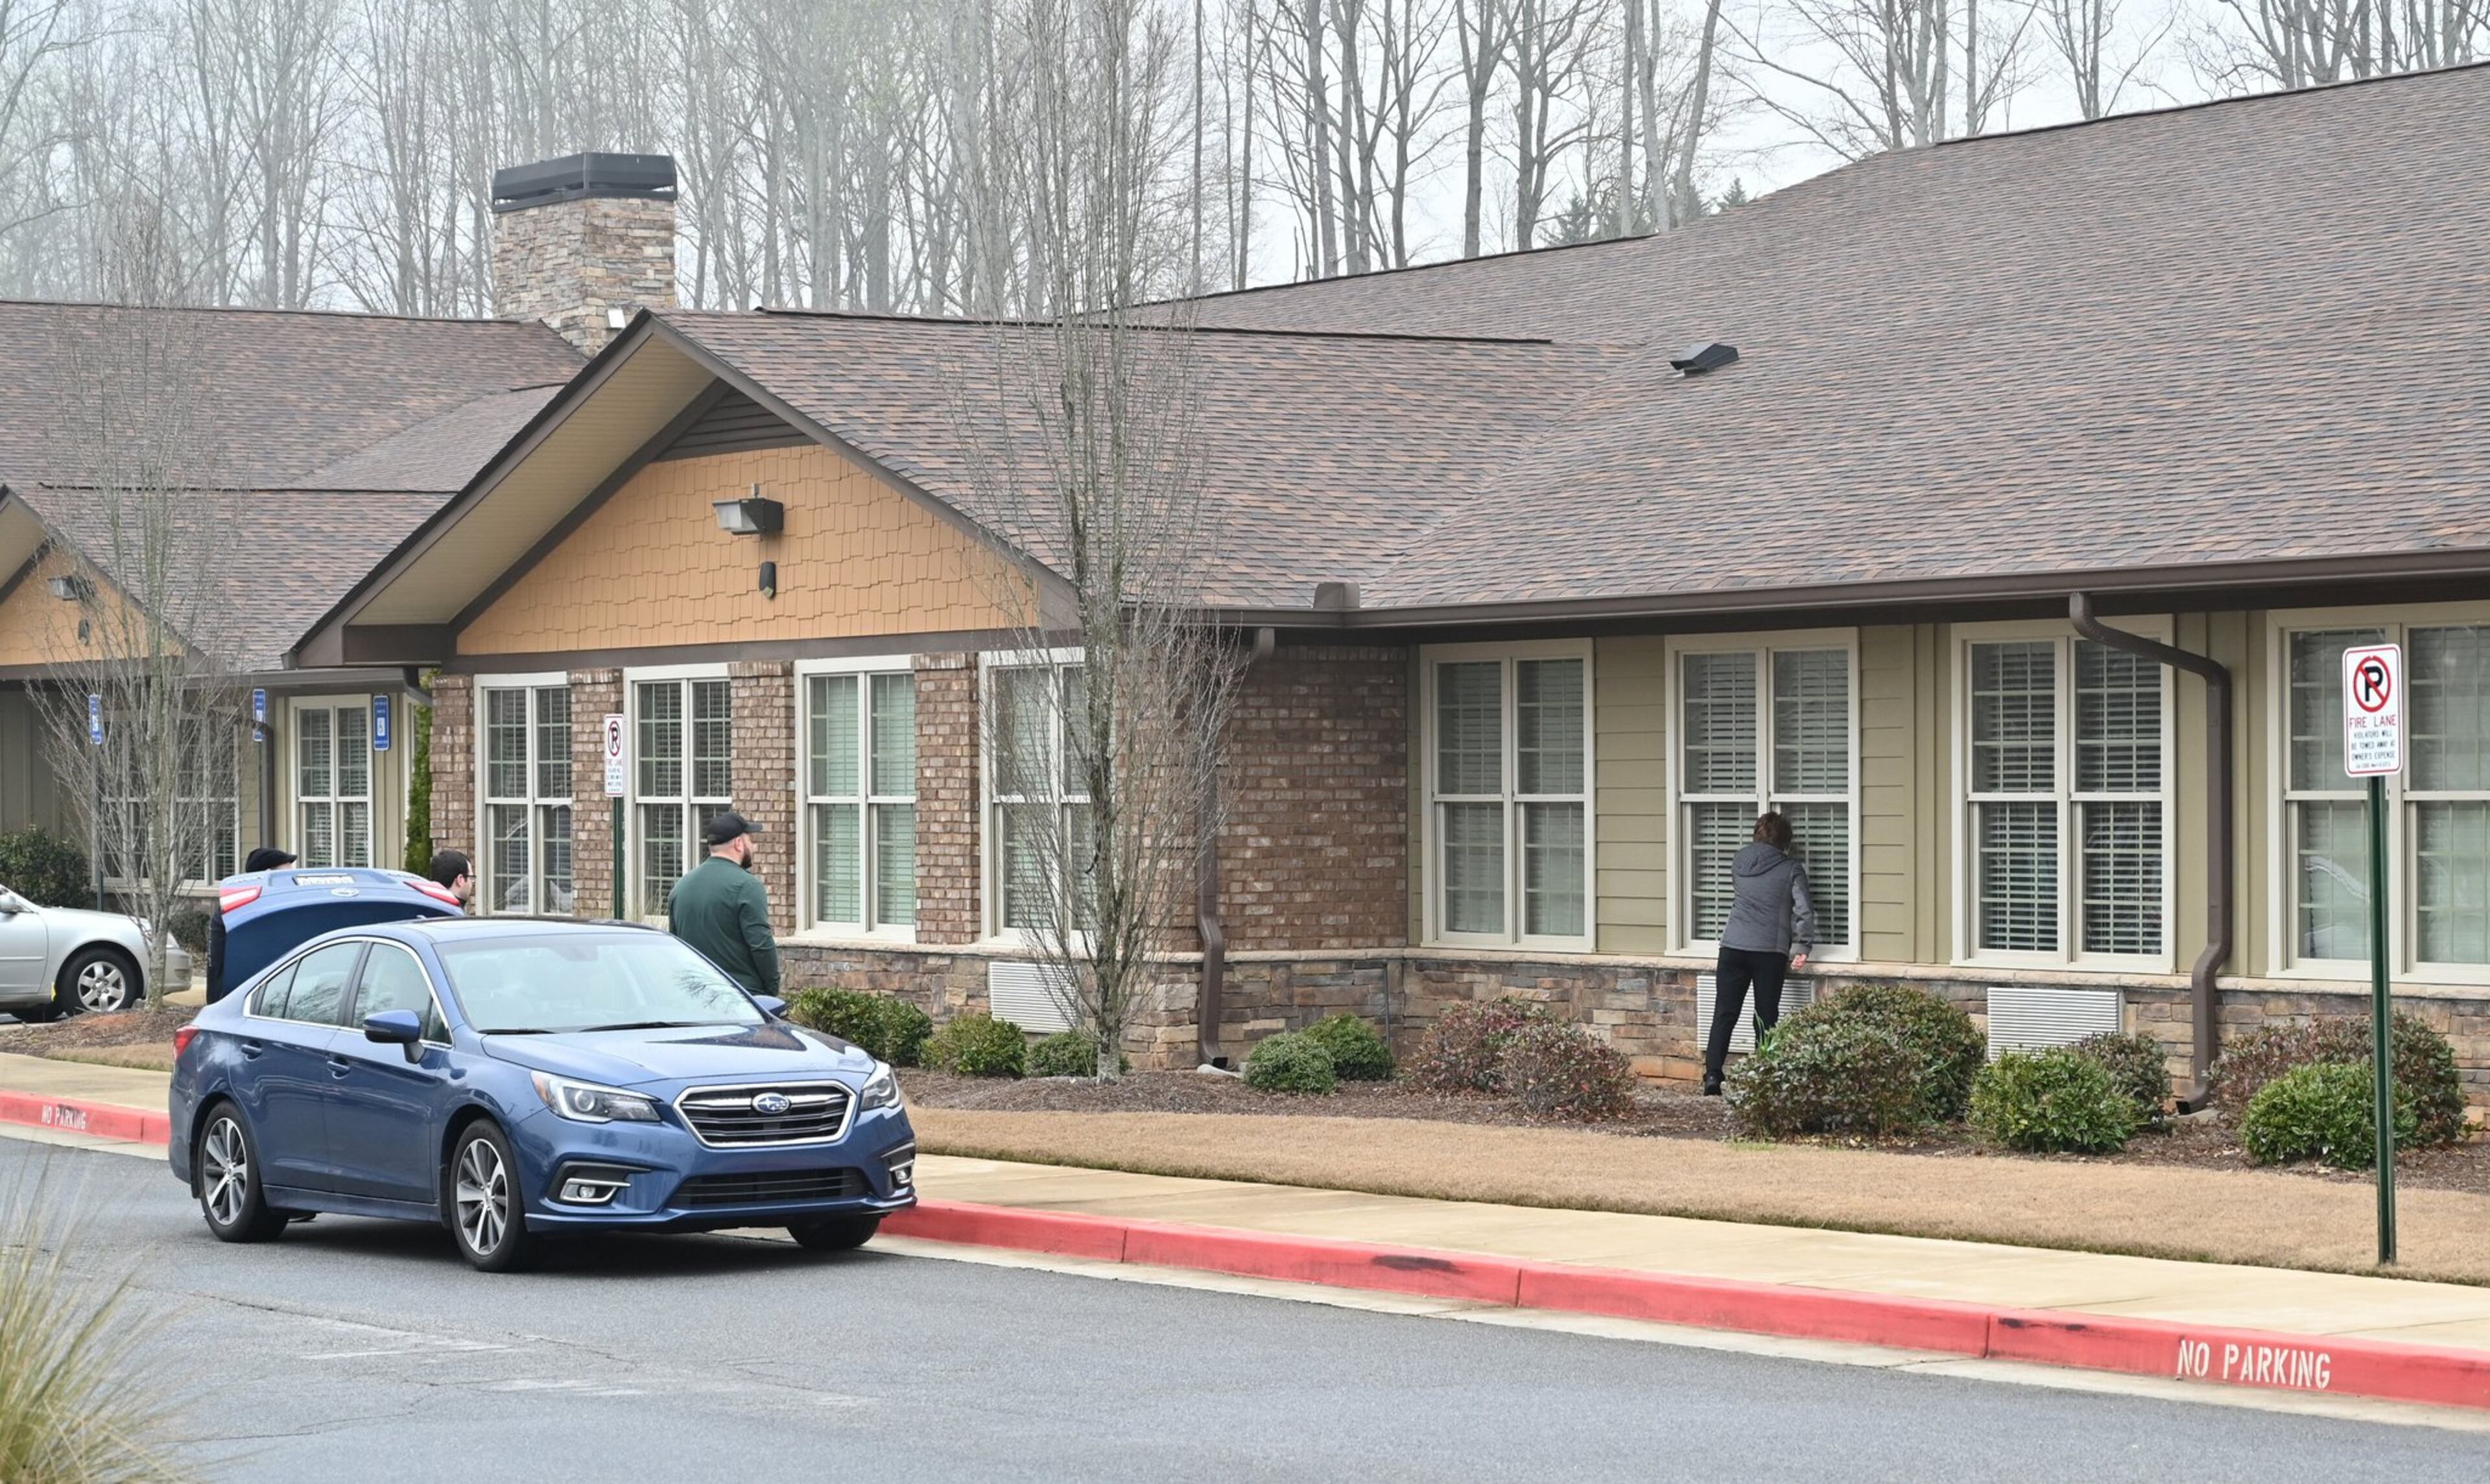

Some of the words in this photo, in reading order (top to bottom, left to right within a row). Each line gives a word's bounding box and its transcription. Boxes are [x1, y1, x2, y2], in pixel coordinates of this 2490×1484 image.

[2349, 716, 2367, 729] FIRE
[2374, 714, 2396, 727] LANE
[41, 1105, 52, 1124] NO
[54, 1107, 86, 1129] PARKING
[2177, 1339, 2210, 1377] NO
[2223, 1344, 2330, 1389] PARKING
